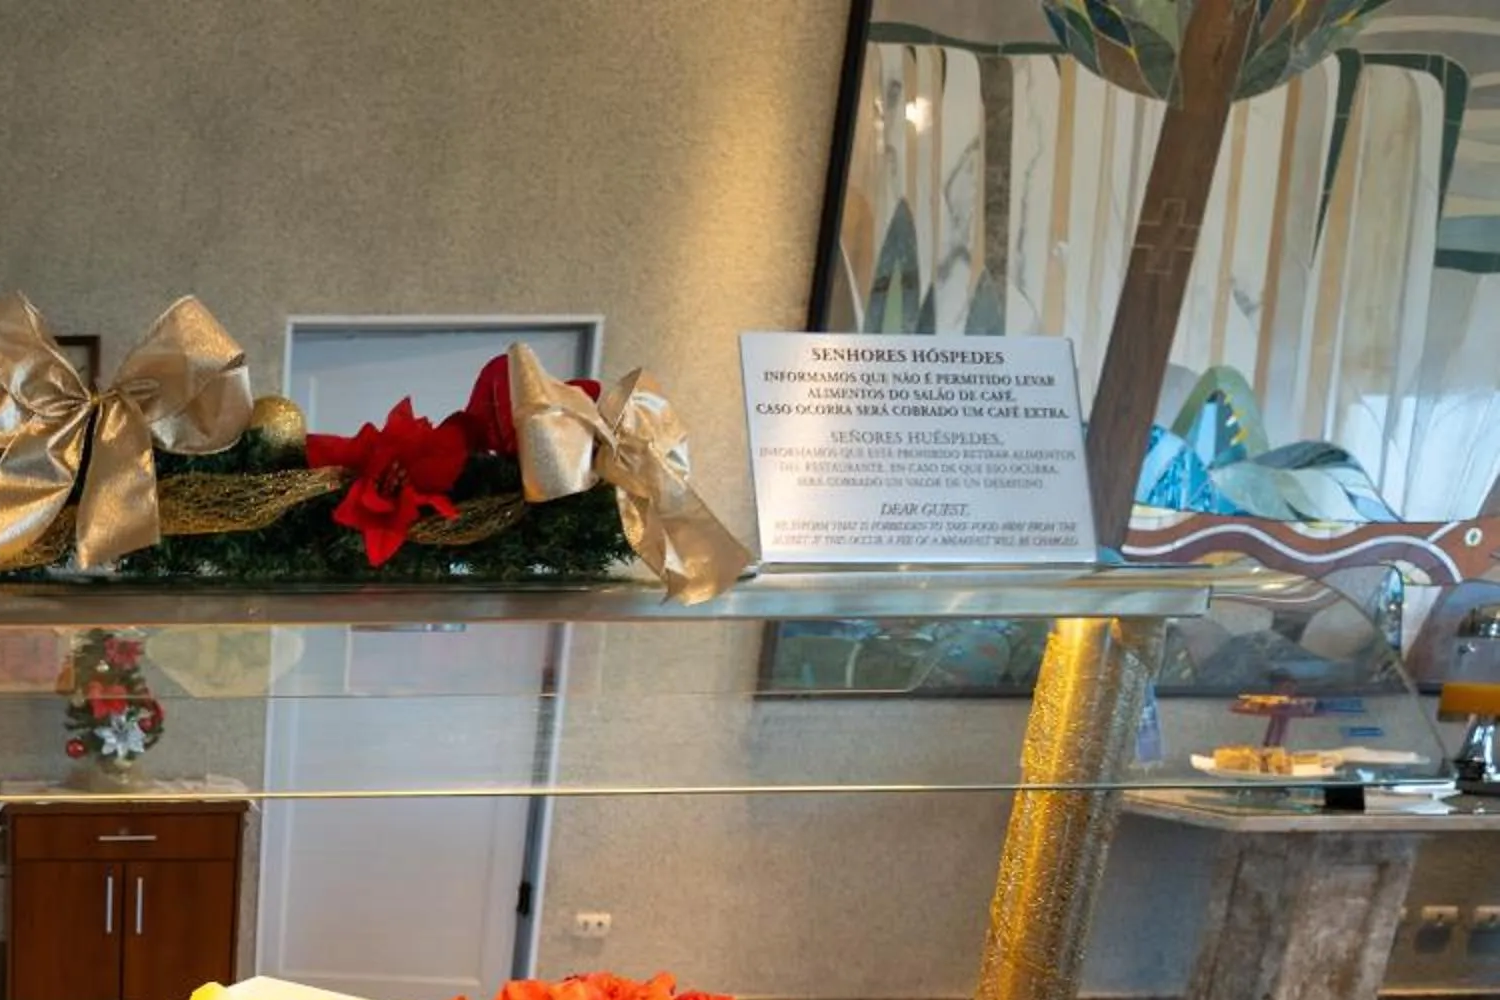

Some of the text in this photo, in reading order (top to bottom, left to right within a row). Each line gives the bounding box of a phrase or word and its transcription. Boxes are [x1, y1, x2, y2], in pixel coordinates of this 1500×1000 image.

[811, 347, 1005, 365] SENHORES HÓSPEDES
[763, 370, 1056, 387] INFORMAMOS QUE NÃO É PERMITIDO LEVAR
[807, 388, 885, 400] ALIMENTOS
[889, 389, 909, 400] DO
[913, 388, 955, 401] SALÃO
[959, 390, 975, 401] DE
[756, 403, 791, 415] CASO
[795, 404, 853, 416] OCORRA
[856, 403, 889, 416] SERÁ
[892, 404, 959, 417] COBRADO
[963, 407, 984, 418] UM
[830, 429, 903, 445] SEÑORES
[880, 502, 919, 516] DEAR
